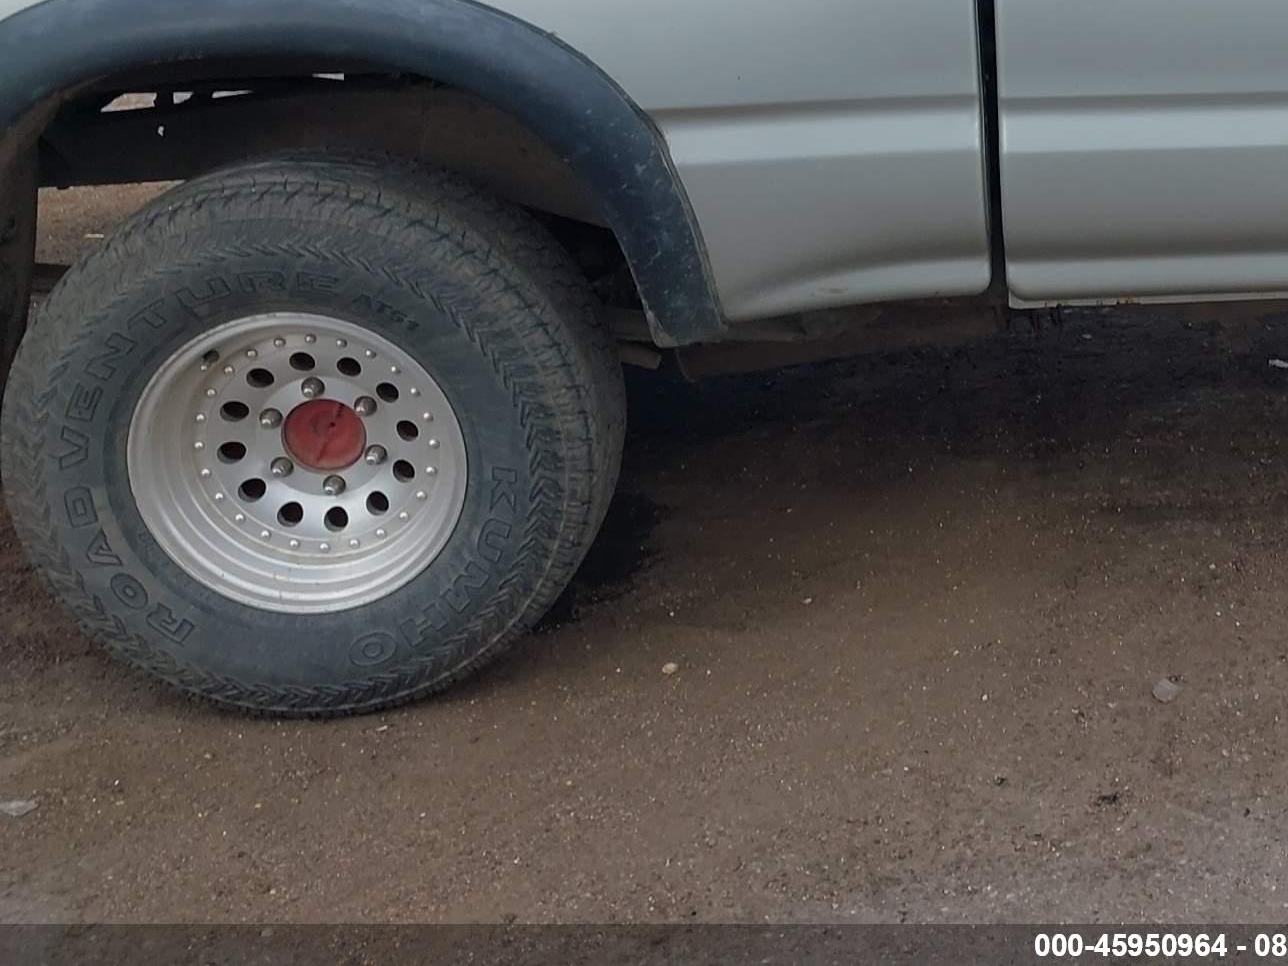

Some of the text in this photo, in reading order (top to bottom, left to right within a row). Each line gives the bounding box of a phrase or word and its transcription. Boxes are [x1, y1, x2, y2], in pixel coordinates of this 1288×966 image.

[57, 270, 337, 470] VENTURE
[64, 486, 196, 645] ROAD
[350, 465, 519, 666] KUMHO
